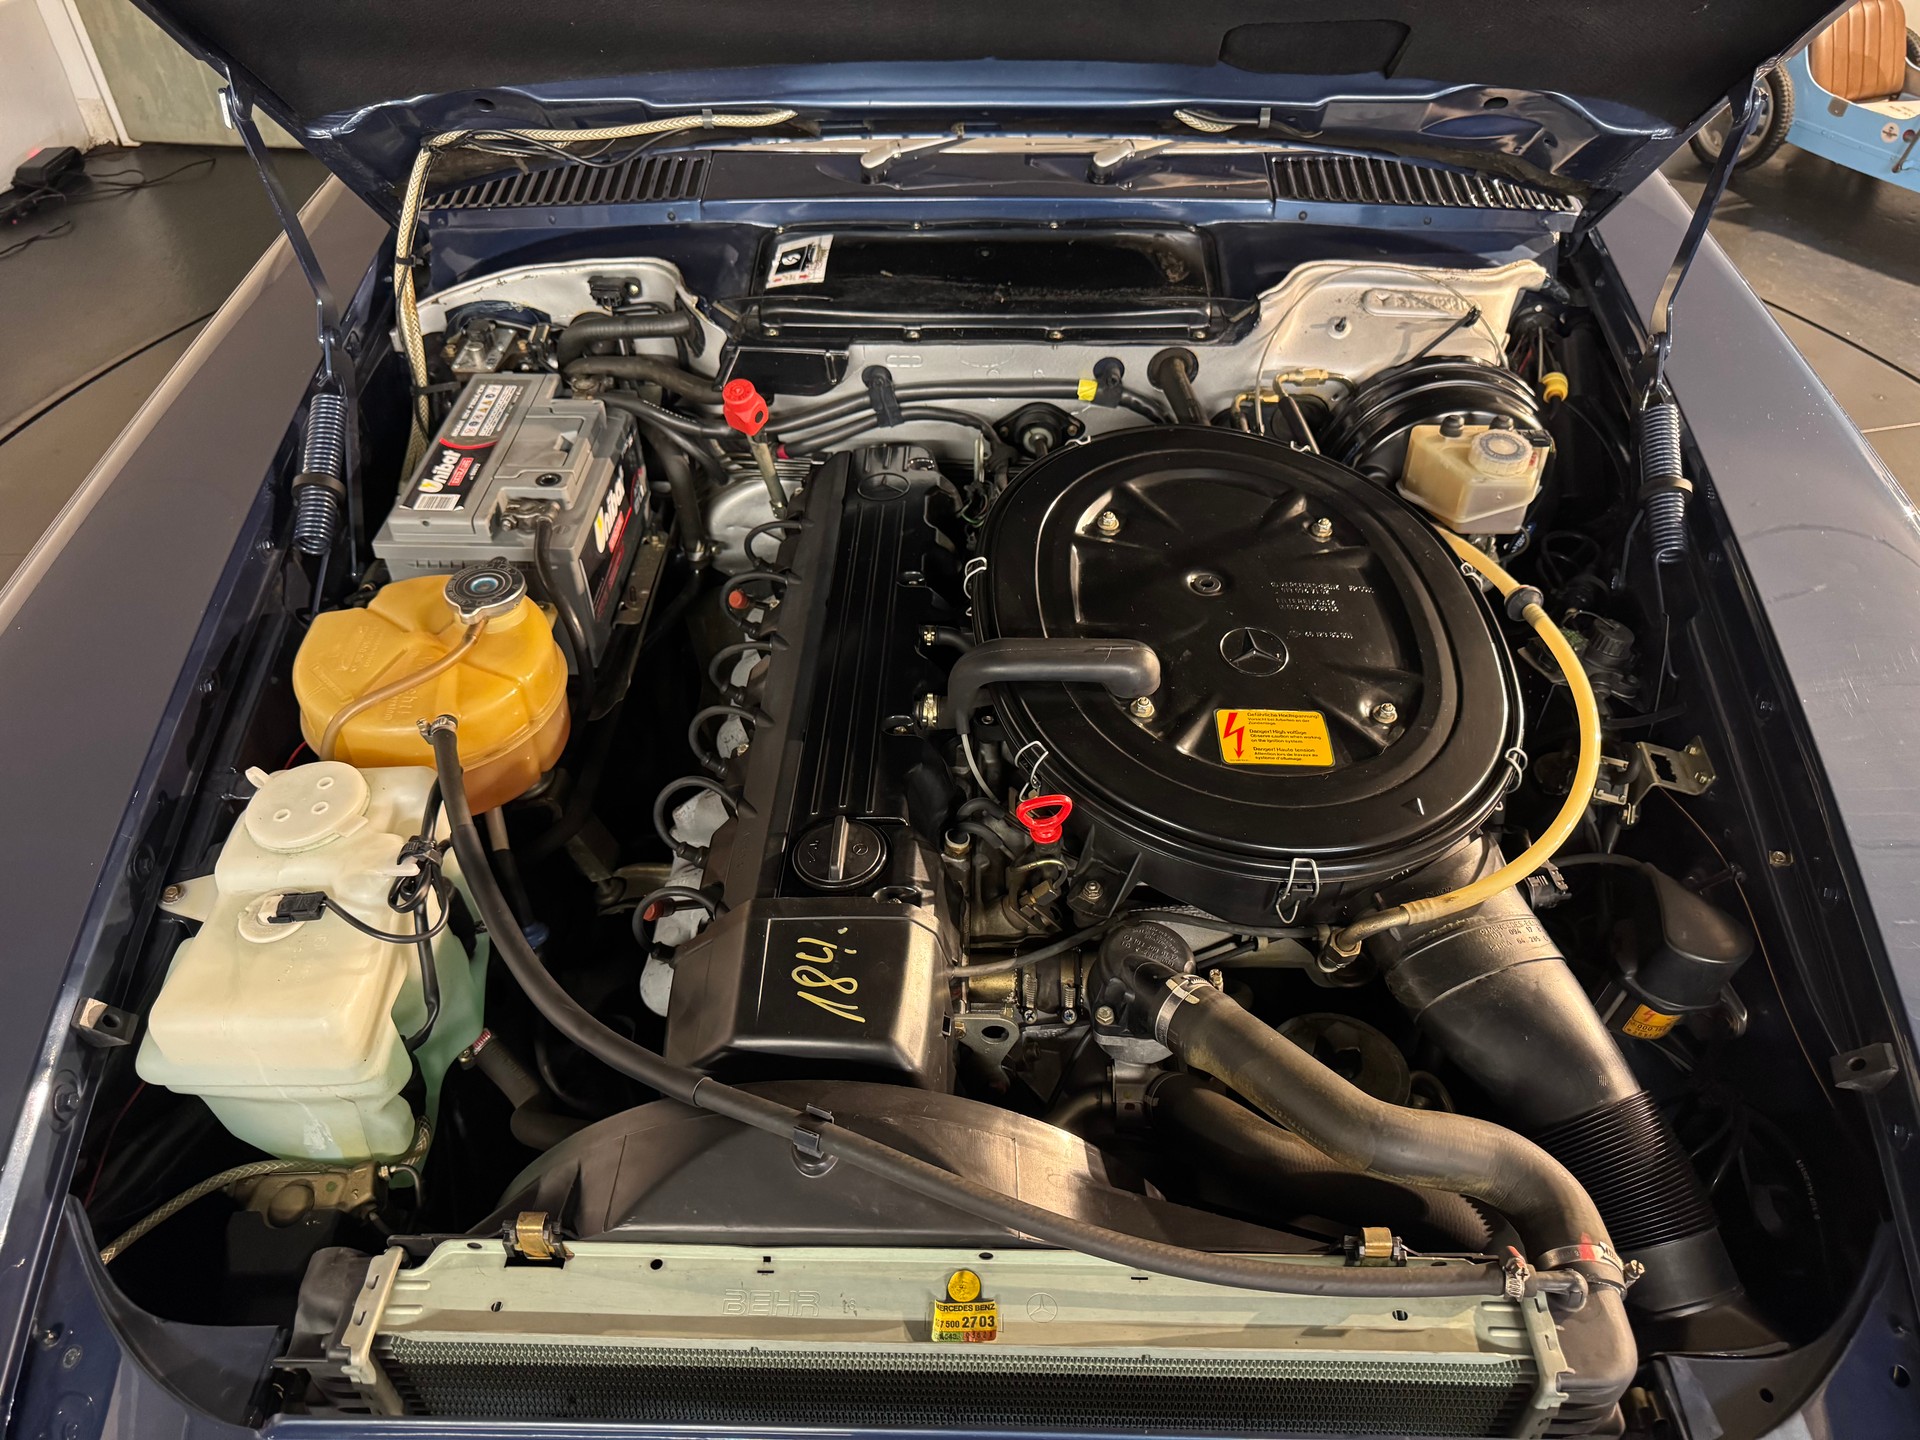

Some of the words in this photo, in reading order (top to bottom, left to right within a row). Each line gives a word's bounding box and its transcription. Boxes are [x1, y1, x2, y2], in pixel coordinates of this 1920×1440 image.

[418, 449, 461, 493] Unibat
[722, 1289, 820, 1317] BEHR
[975, 1303, 996, 1311] BENZ
[962, 1315, 995, 1328] 2703
